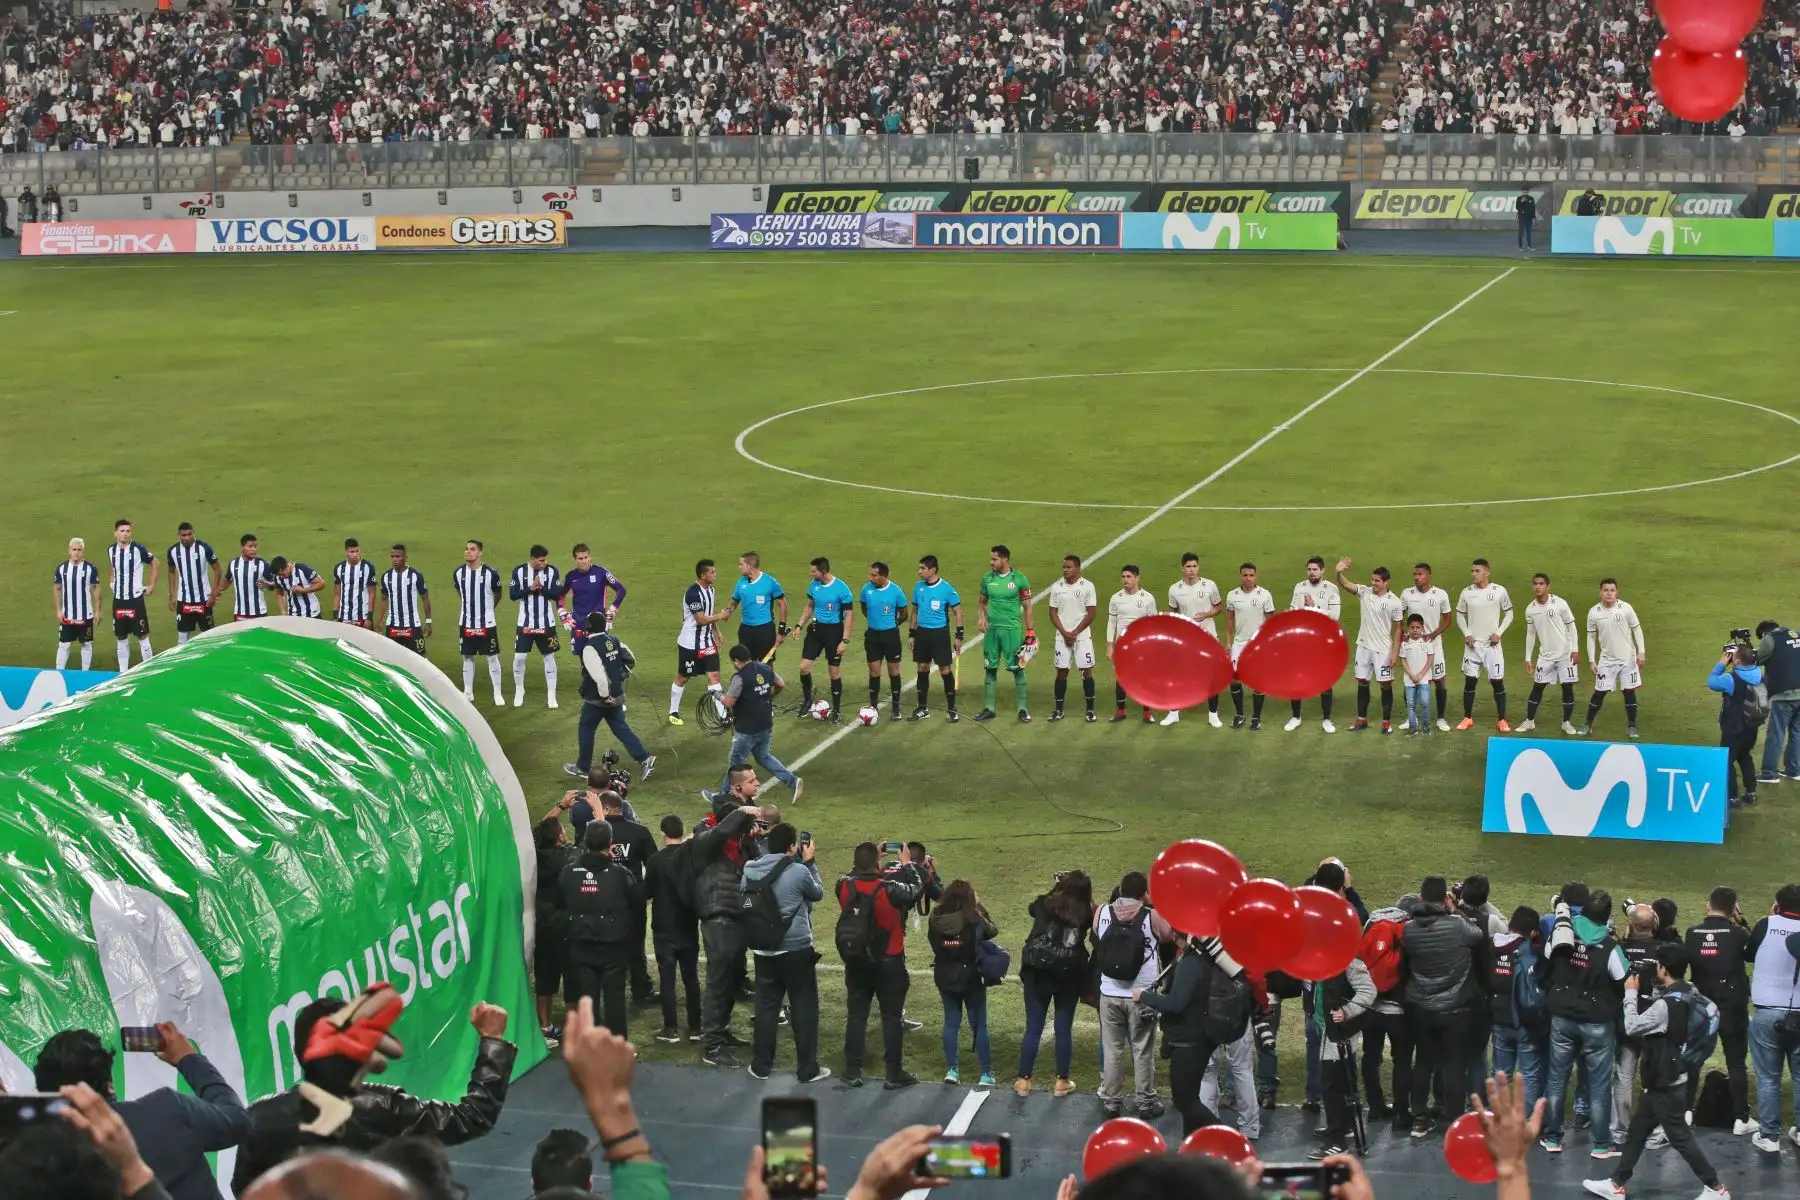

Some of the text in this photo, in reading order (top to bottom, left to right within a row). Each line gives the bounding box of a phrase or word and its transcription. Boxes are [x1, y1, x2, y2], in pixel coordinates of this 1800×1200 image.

[784, 192, 866, 212] depor
[972, 191, 1056, 212] depor
[1168, 192, 1254, 213] depor
[1368, 190, 1456, 216] depor
[1570, 195, 1658, 216] por
[40, 223, 94, 236] Financiera
[451, 216, 556, 243] Gents
[752, 213, 861, 230] SERVIS PIURA
[210, 218, 360, 243] VECSOL
[382, 225, 446, 238] Condones
[764, 231, 861, 246] 997 500 833
[933, 216, 1101, 245] marathon
[1246, 222, 1267, 240] Tv
[1680, 227, 1702, 245] Tv
[212, 244, 296, 252] LUBRICANTES
[416, 638, 425, 649] 19
[1085, 652, 1092, 663] 5
[1434, 662, 1444, 674] 20
[1494, 664, 1500, 674] 7
[1566, 667, 1574, 678] 11
[1630, 672, 1637, 684] 10
[1657, 767, 1710, 814] Tv
